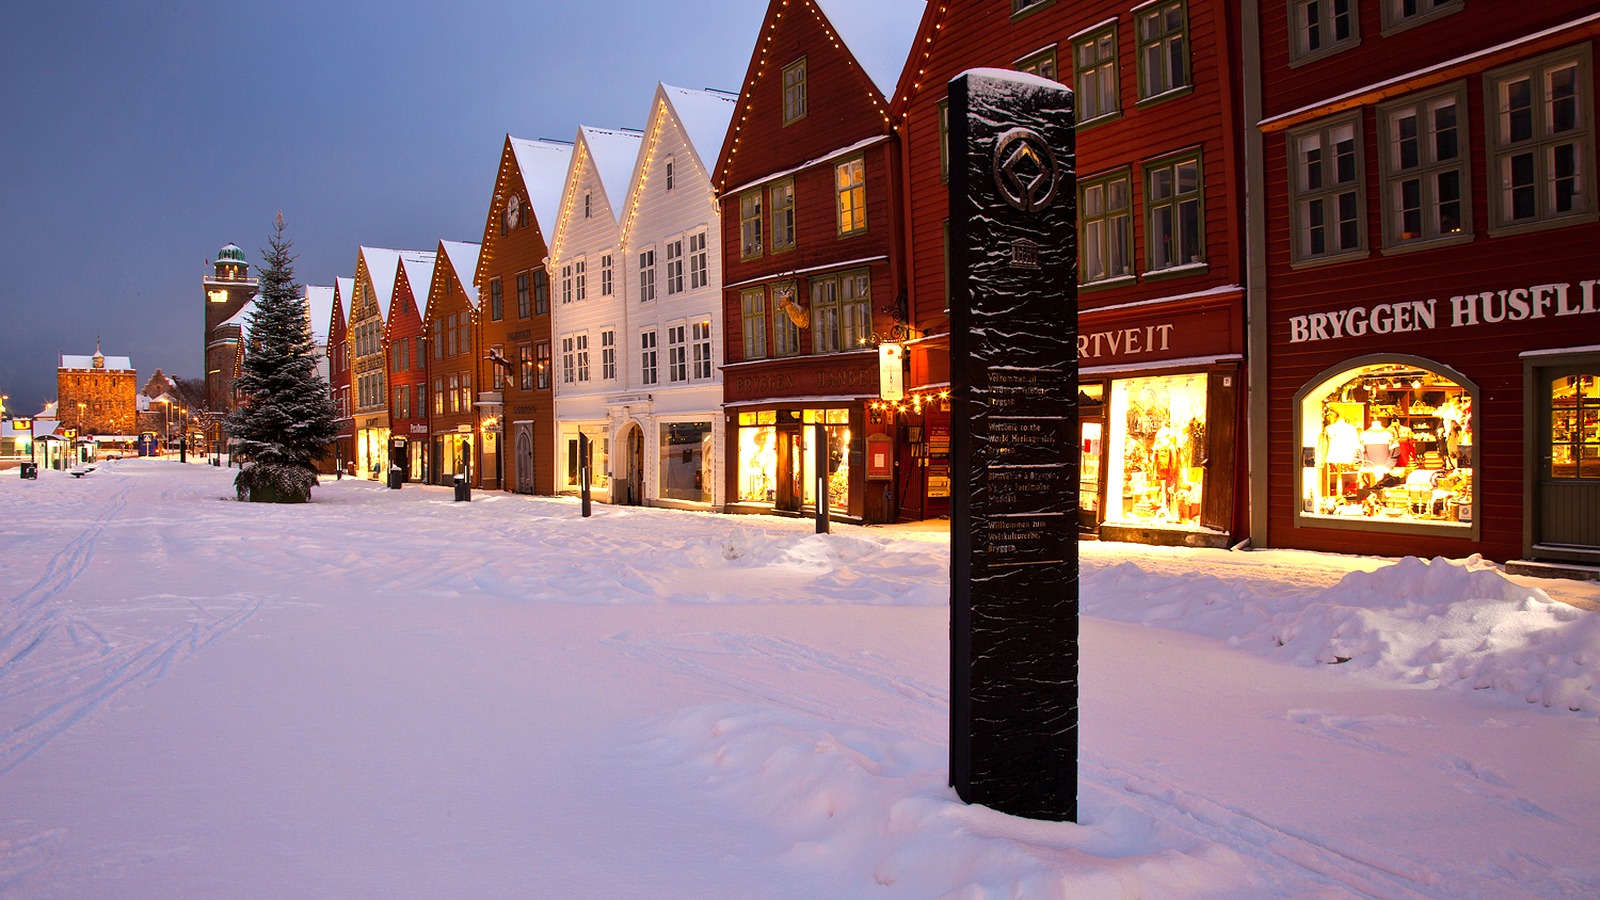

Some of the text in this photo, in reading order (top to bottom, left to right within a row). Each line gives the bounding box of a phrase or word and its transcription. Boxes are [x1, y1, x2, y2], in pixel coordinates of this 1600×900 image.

[1289, 279, 1600, 343] BRYGGEN HUSFLI
[1076, 323, 1174, 359] RTVEIT
[736, 368, 879, 394] BRYGGEN HANDEL
[1020, 424, 1028, 432] to
[1030, 423, 1041, 432] the
[988, 434, 1009, 443] World
[1032, 520, 1046, 529] zum
